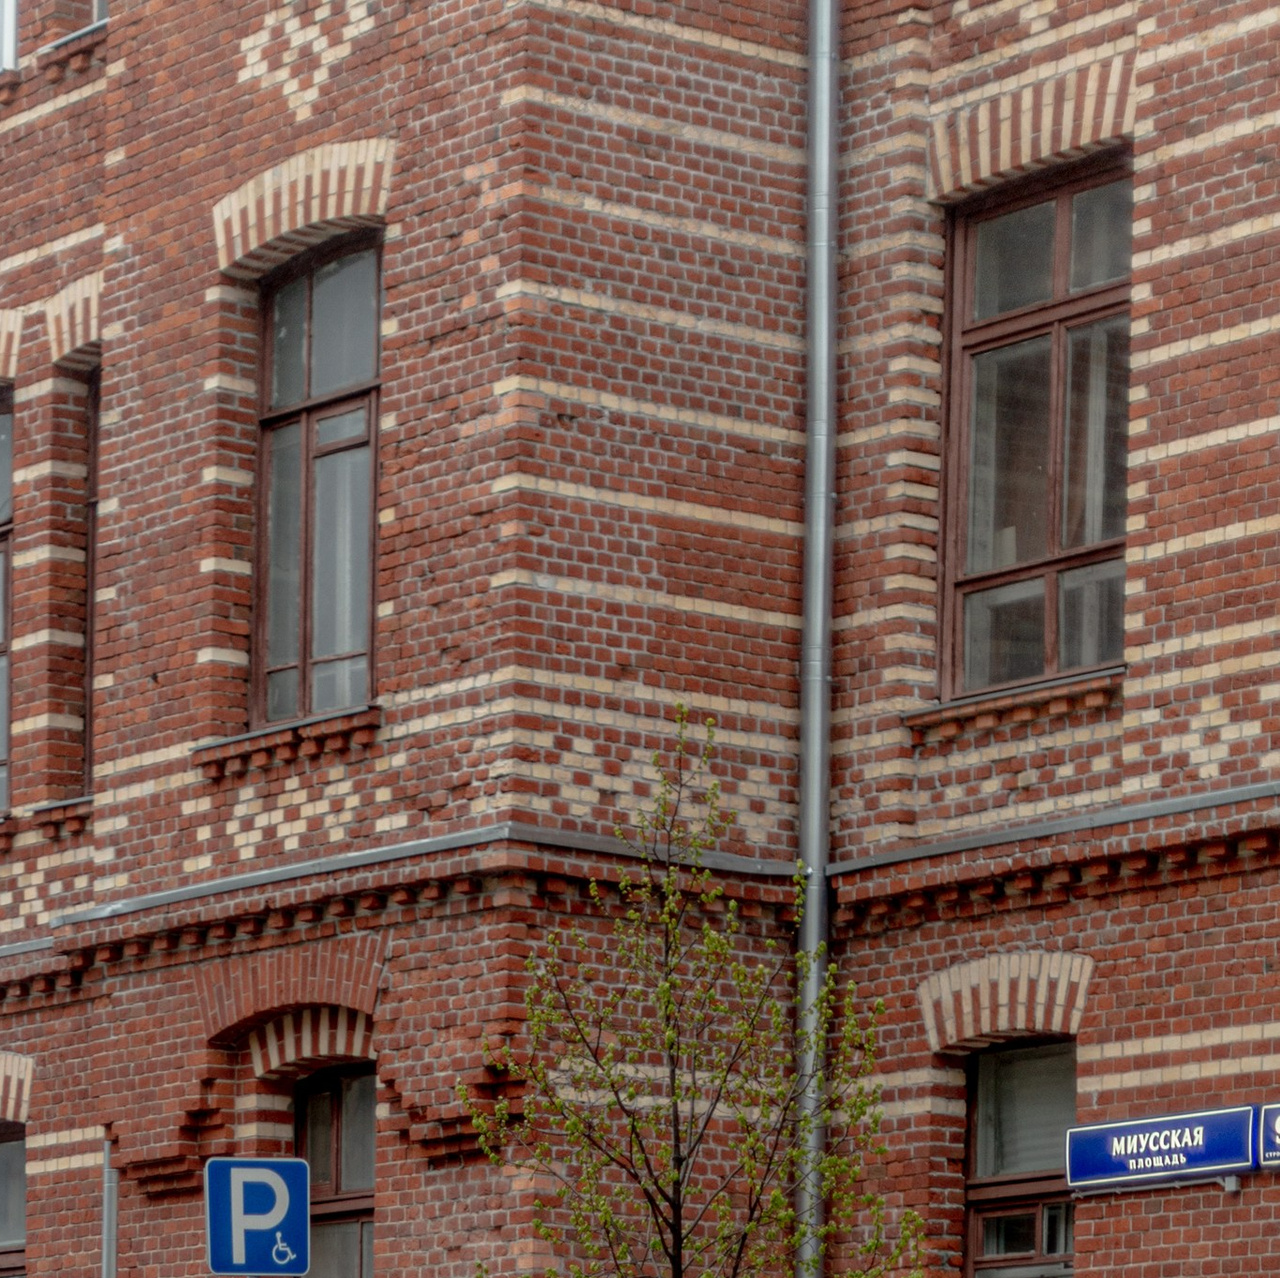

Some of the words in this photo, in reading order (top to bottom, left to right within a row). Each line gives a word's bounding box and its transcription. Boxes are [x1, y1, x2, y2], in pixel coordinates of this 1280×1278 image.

[1112, 1126, 1204, 1156] МИУССКАЯ
[1129, 1153, 1187, 1170] ПЛОЩАДЬ
[230, 1167, 290, 1264] P
